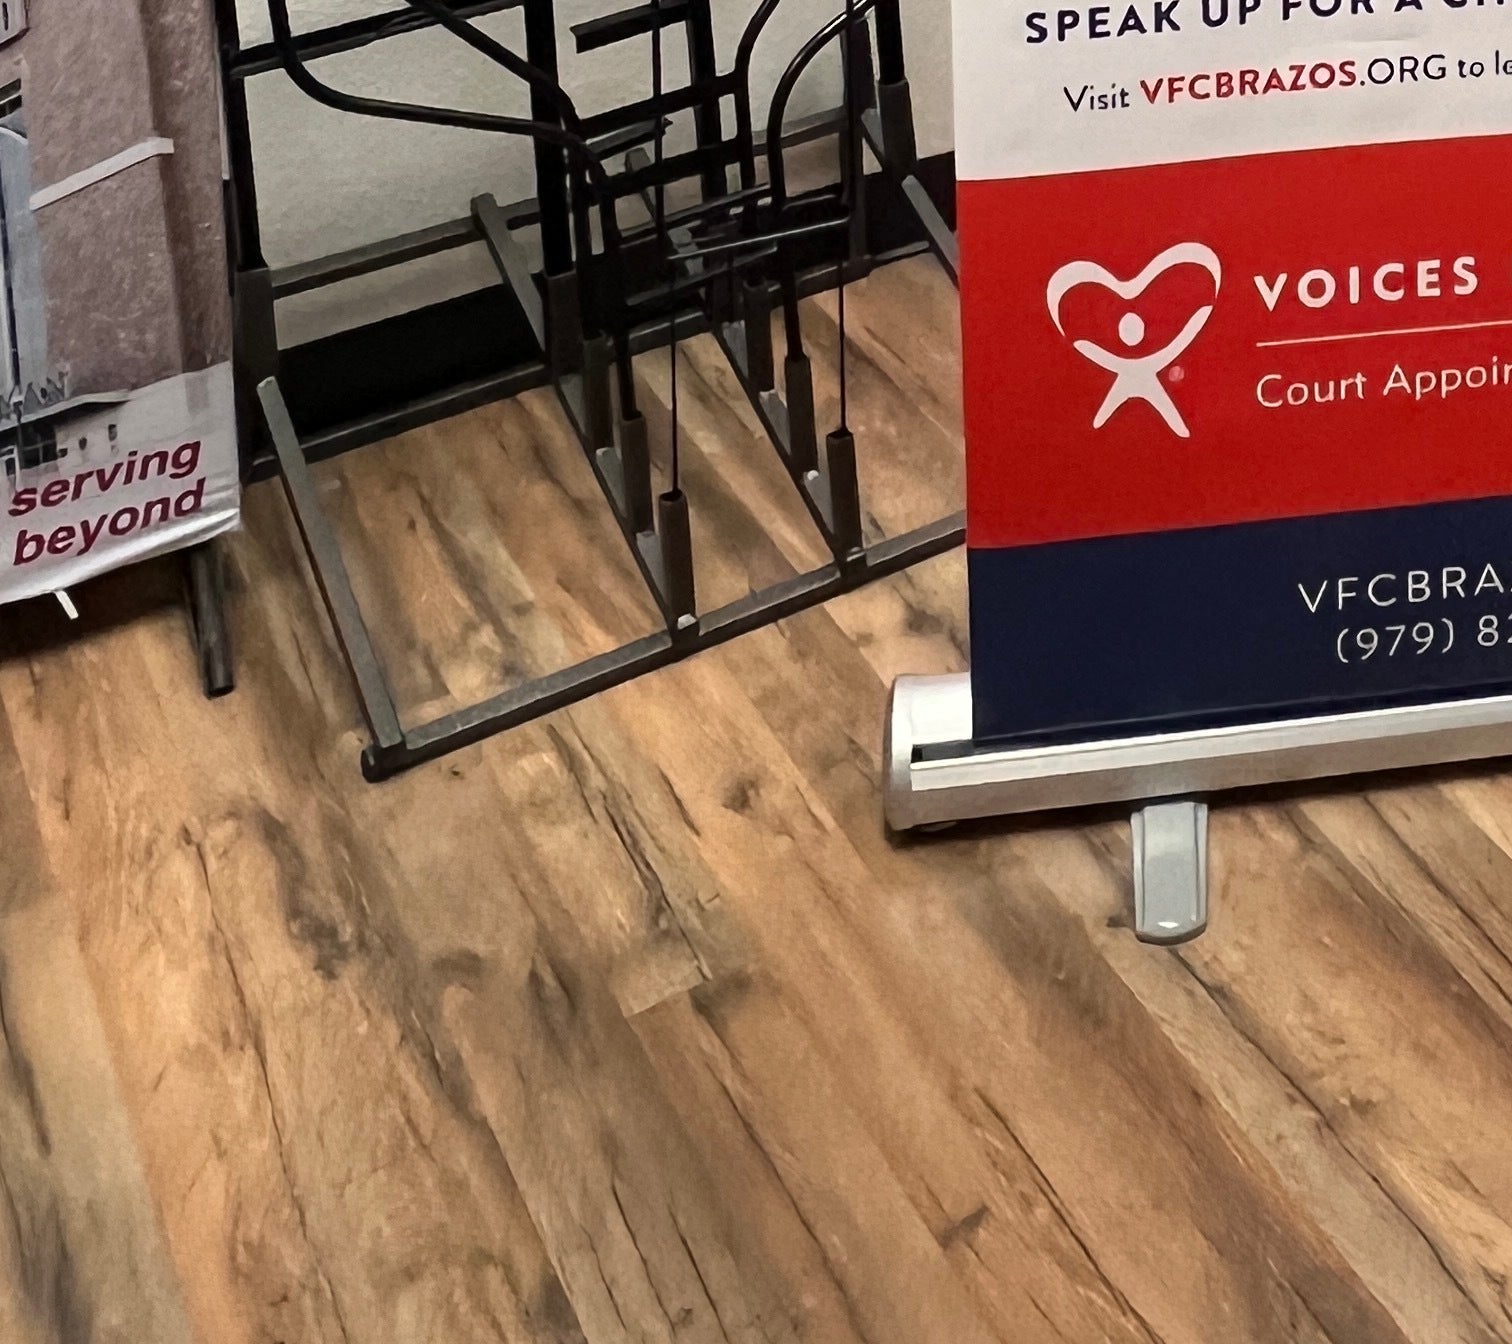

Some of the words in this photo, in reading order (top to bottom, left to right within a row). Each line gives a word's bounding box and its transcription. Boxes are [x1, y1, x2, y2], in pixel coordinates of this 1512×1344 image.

[1026, 0, 1180, 43] SPEAK
[1064, 85, 1130, 113] Visit
[1140, 54, 1446, 105] VFCBRAZOS.ORG
[1458, 59, 1484, 79] to
[1254, 257, 1477, 311] VOICES
[1257, 372, 1367, 408] Court
[10, 440, 201, 516] serving
[12, 477, 206, 566] beyond
[1337, 618, 1453, 663] (979)
